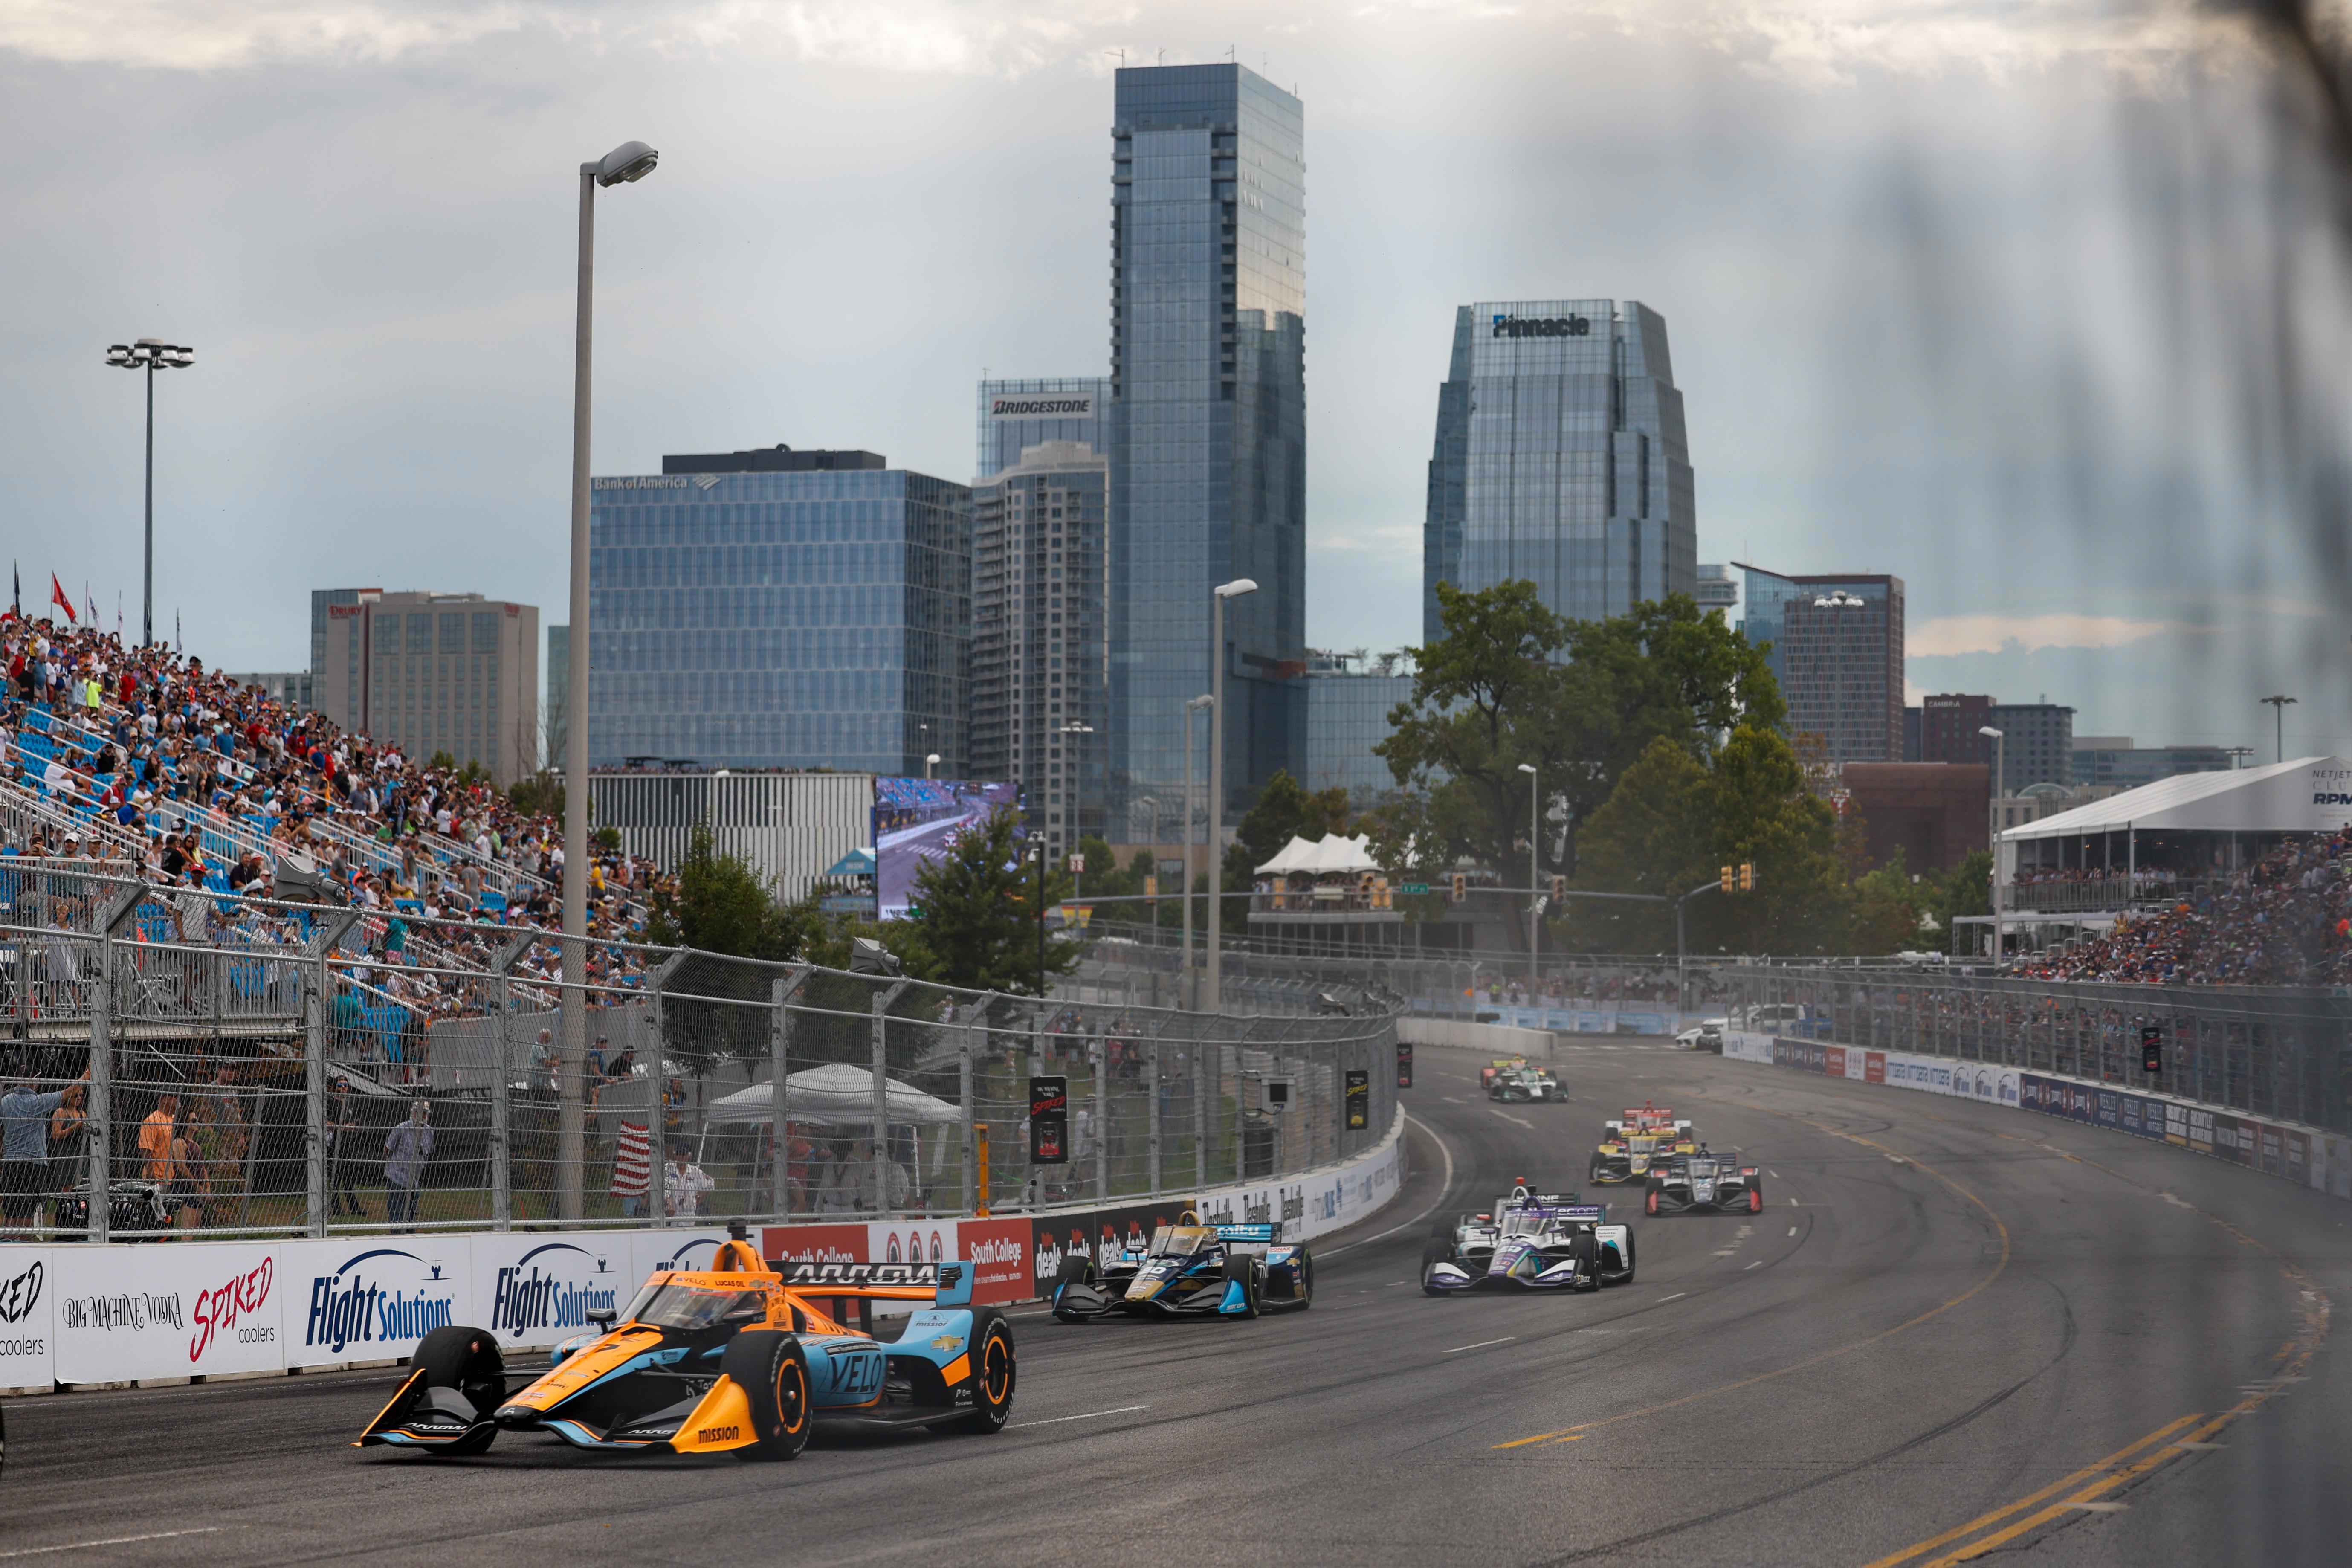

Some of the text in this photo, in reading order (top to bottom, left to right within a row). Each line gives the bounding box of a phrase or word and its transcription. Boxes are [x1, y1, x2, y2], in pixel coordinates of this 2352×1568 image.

[1494, 313, 1589, 337] Pinnacle
[993, 399, 1089, 414] BRIDGESTONE
[595, 475, 688, 490] Bank of America
[329, 605, 362, 615] DRURY
[1031, 1096, 1065, 1116] SPIKED
[971, 1237, 1022, 1267] South College
[1036, 1242, 1062, 1279] deals
[1099, 1233, 1121, 1269] deals
[683, 1278, 706, 1286] VELO
[63, 1293, 184, 1331] BIG MACHINE VODKA
[190, 1256, 273, 1362] SPIKED
[306, 1275, 452, 1353] Flight Solutions
[492, 1267, 617, 1338] Flight Solutions
[0, 1334, 44, 1356] coolers
[239, 1323, 275, 1343] coolers
[830, 1354, 881, 1392] VELO
[698, 1426, 739, 1444] mission
